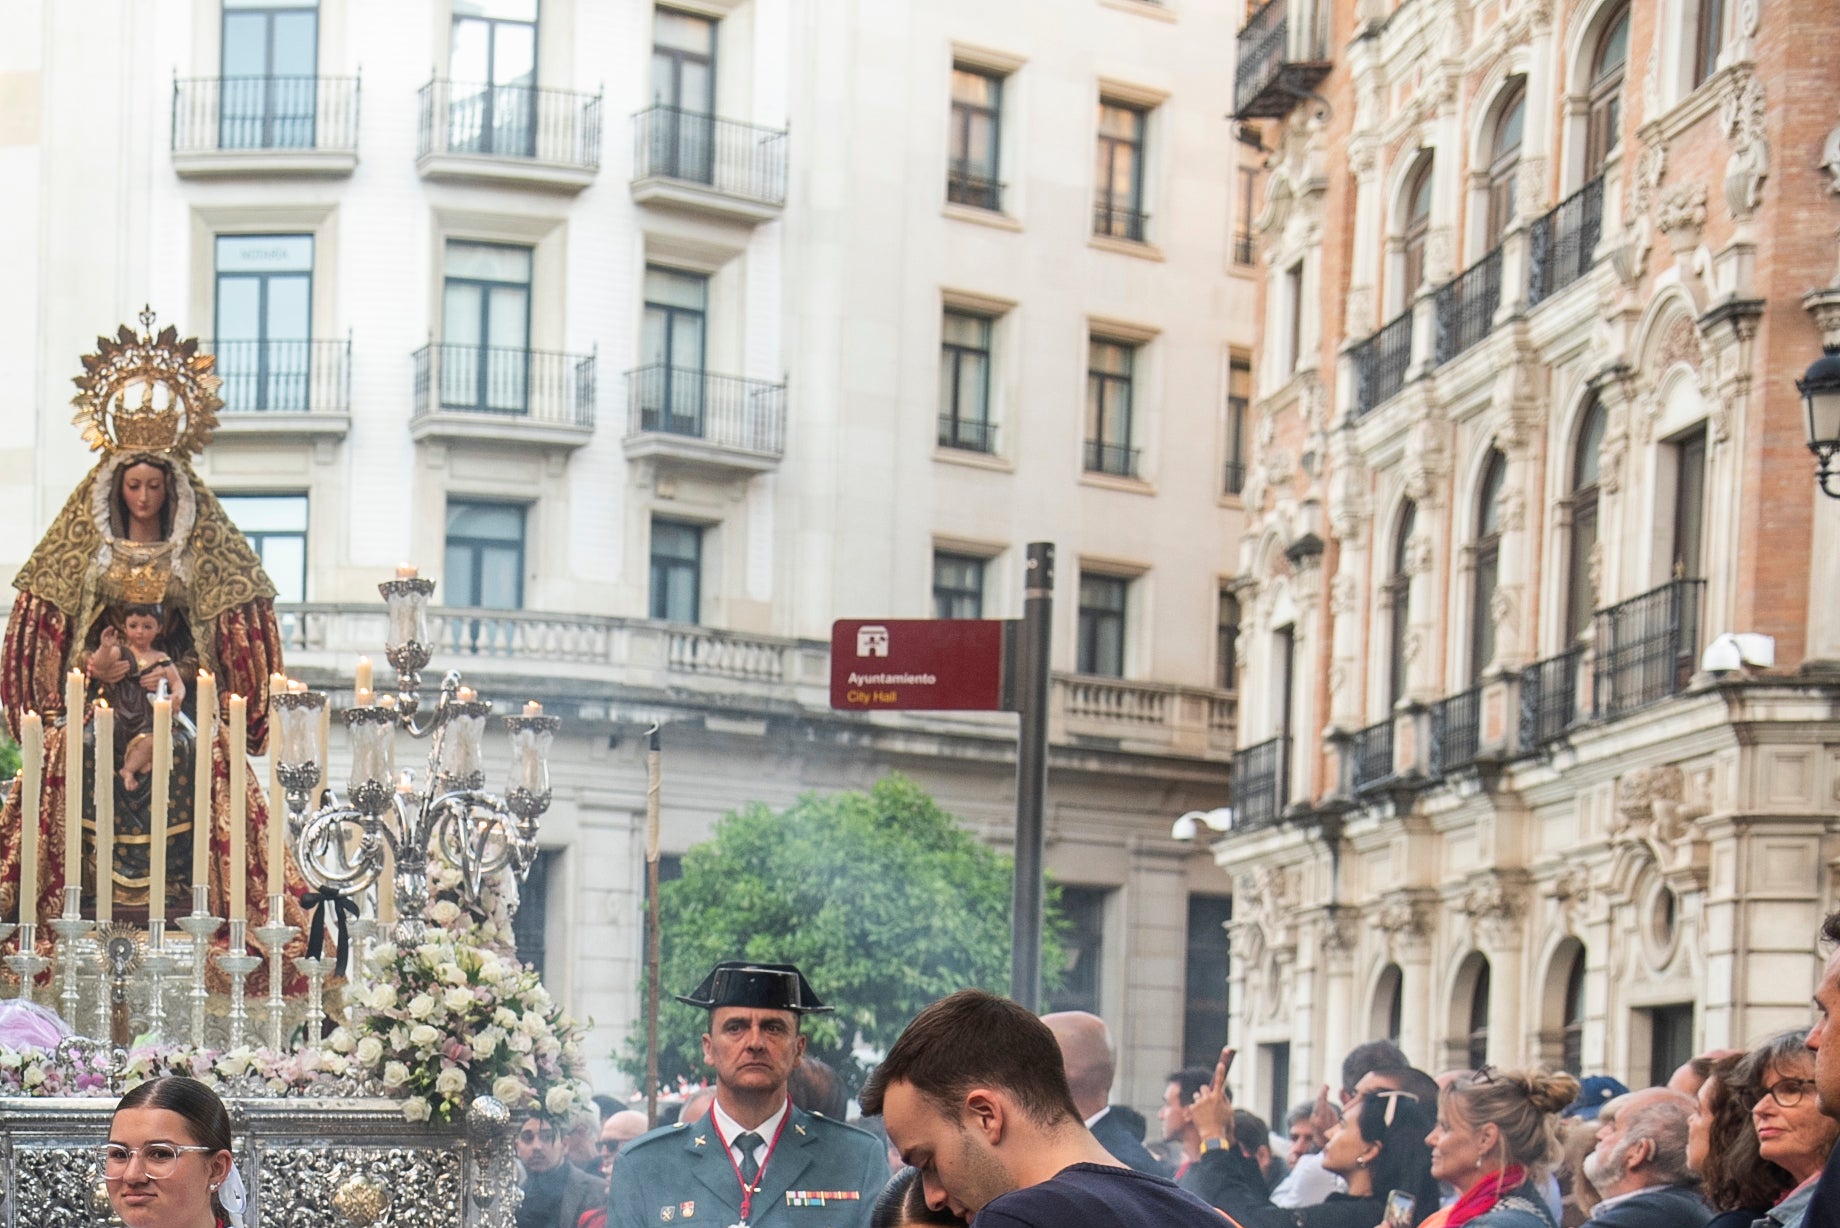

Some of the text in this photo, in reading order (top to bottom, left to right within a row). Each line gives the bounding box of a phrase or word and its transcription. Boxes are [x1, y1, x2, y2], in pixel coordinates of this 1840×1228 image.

[847, 671, 937, 687] Ayuntamiento
[847, 690, 898, 705] City Hall
